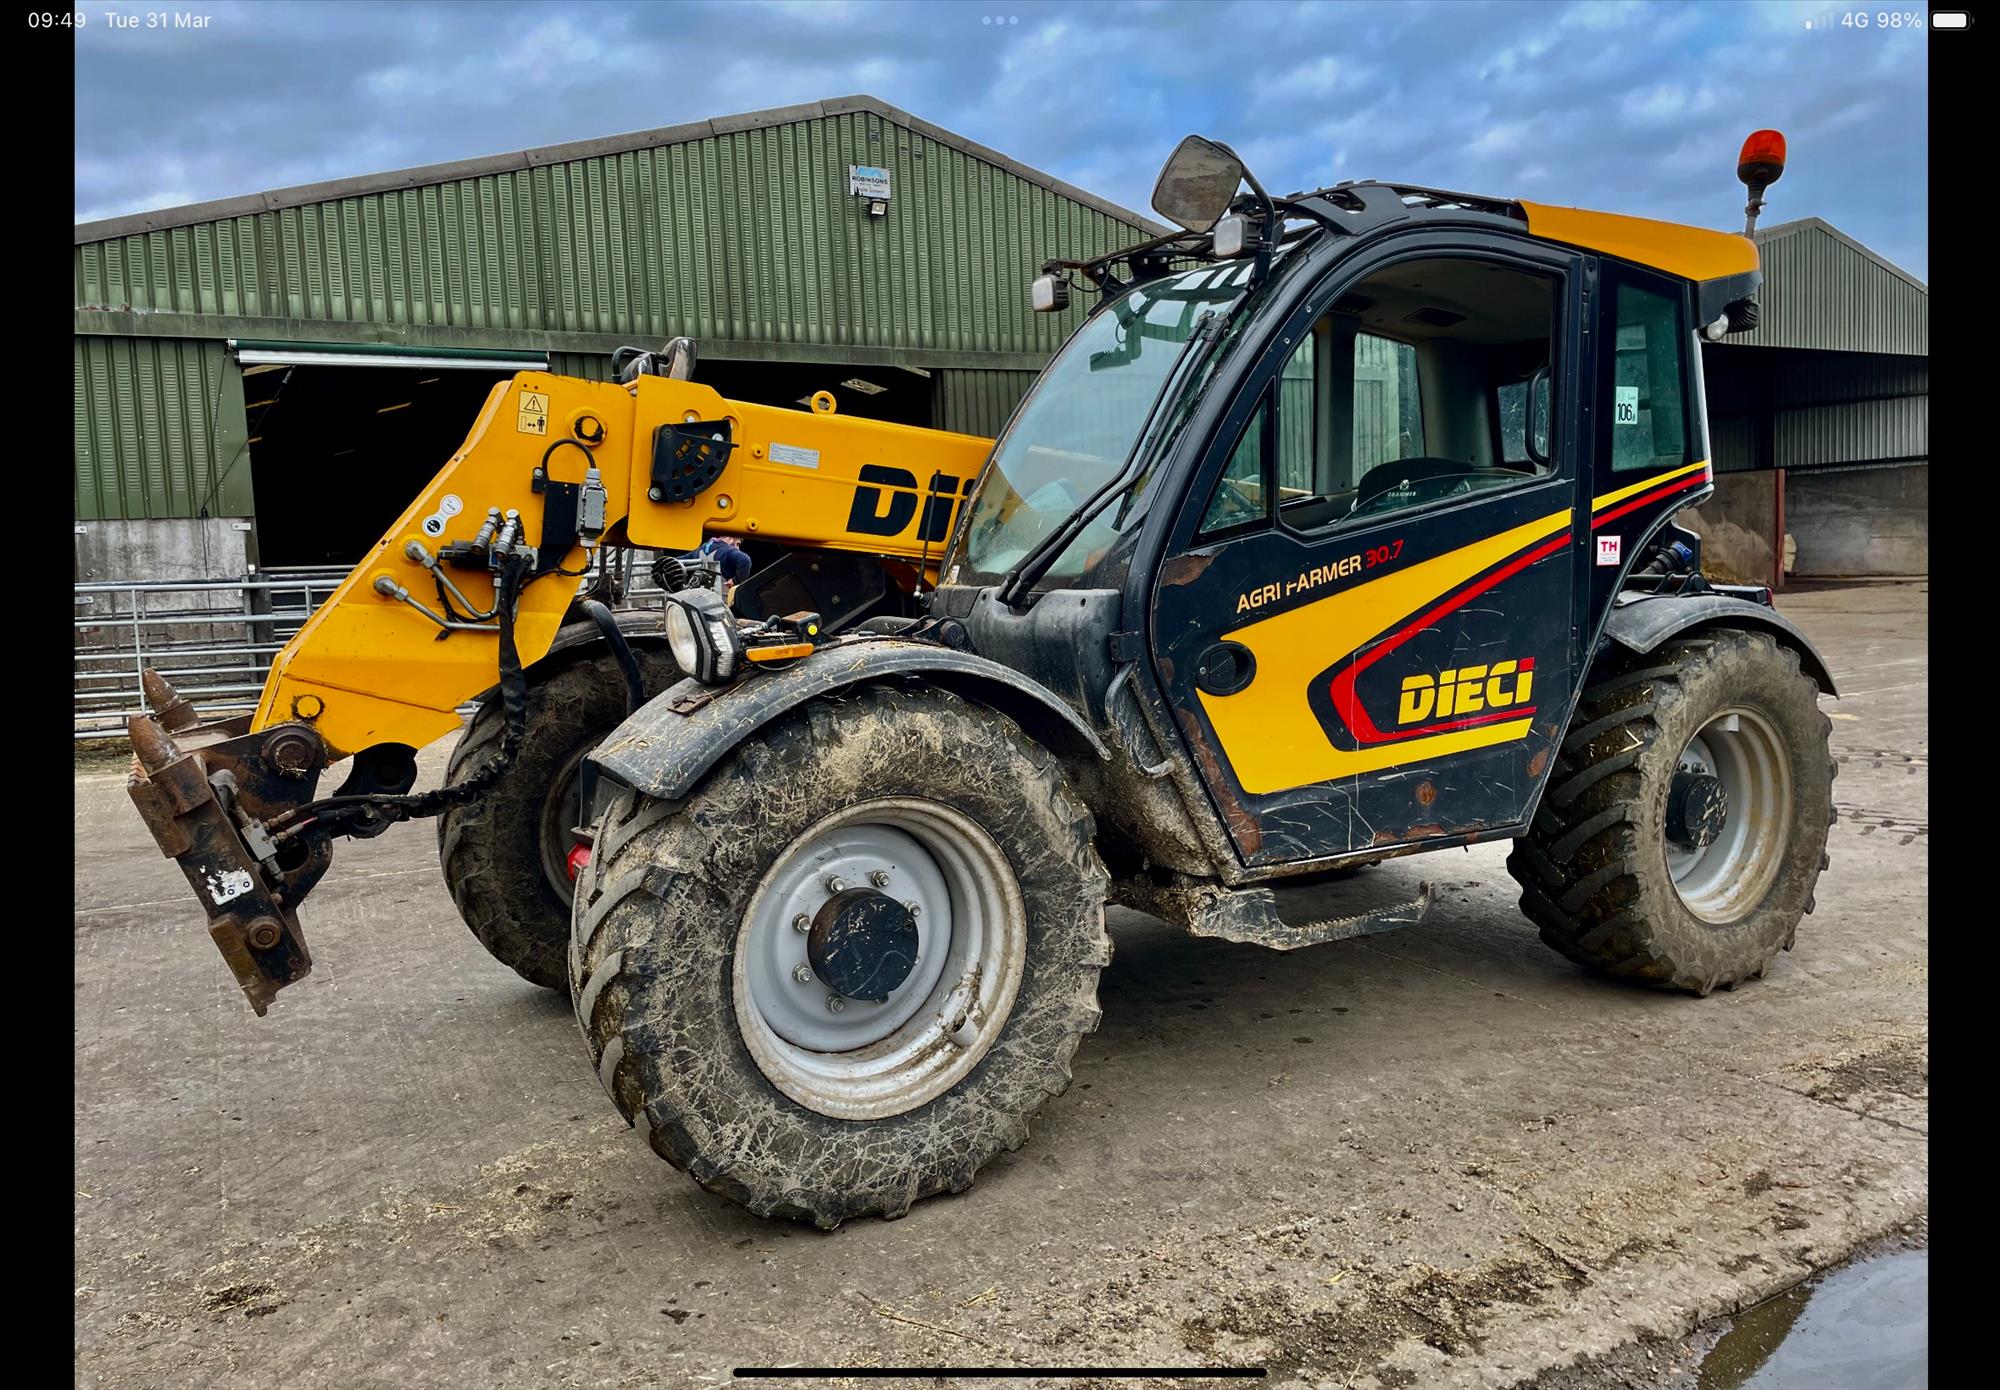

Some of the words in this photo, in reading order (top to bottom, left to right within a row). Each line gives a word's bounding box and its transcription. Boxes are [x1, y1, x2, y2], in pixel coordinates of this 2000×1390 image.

[1617, 403, 1633, 421] 106
[1600, 541, 1617, 552] TH
[1236, 582, 1281, 614] AGRI
[1365, 539, 1404, 569] 30.7
